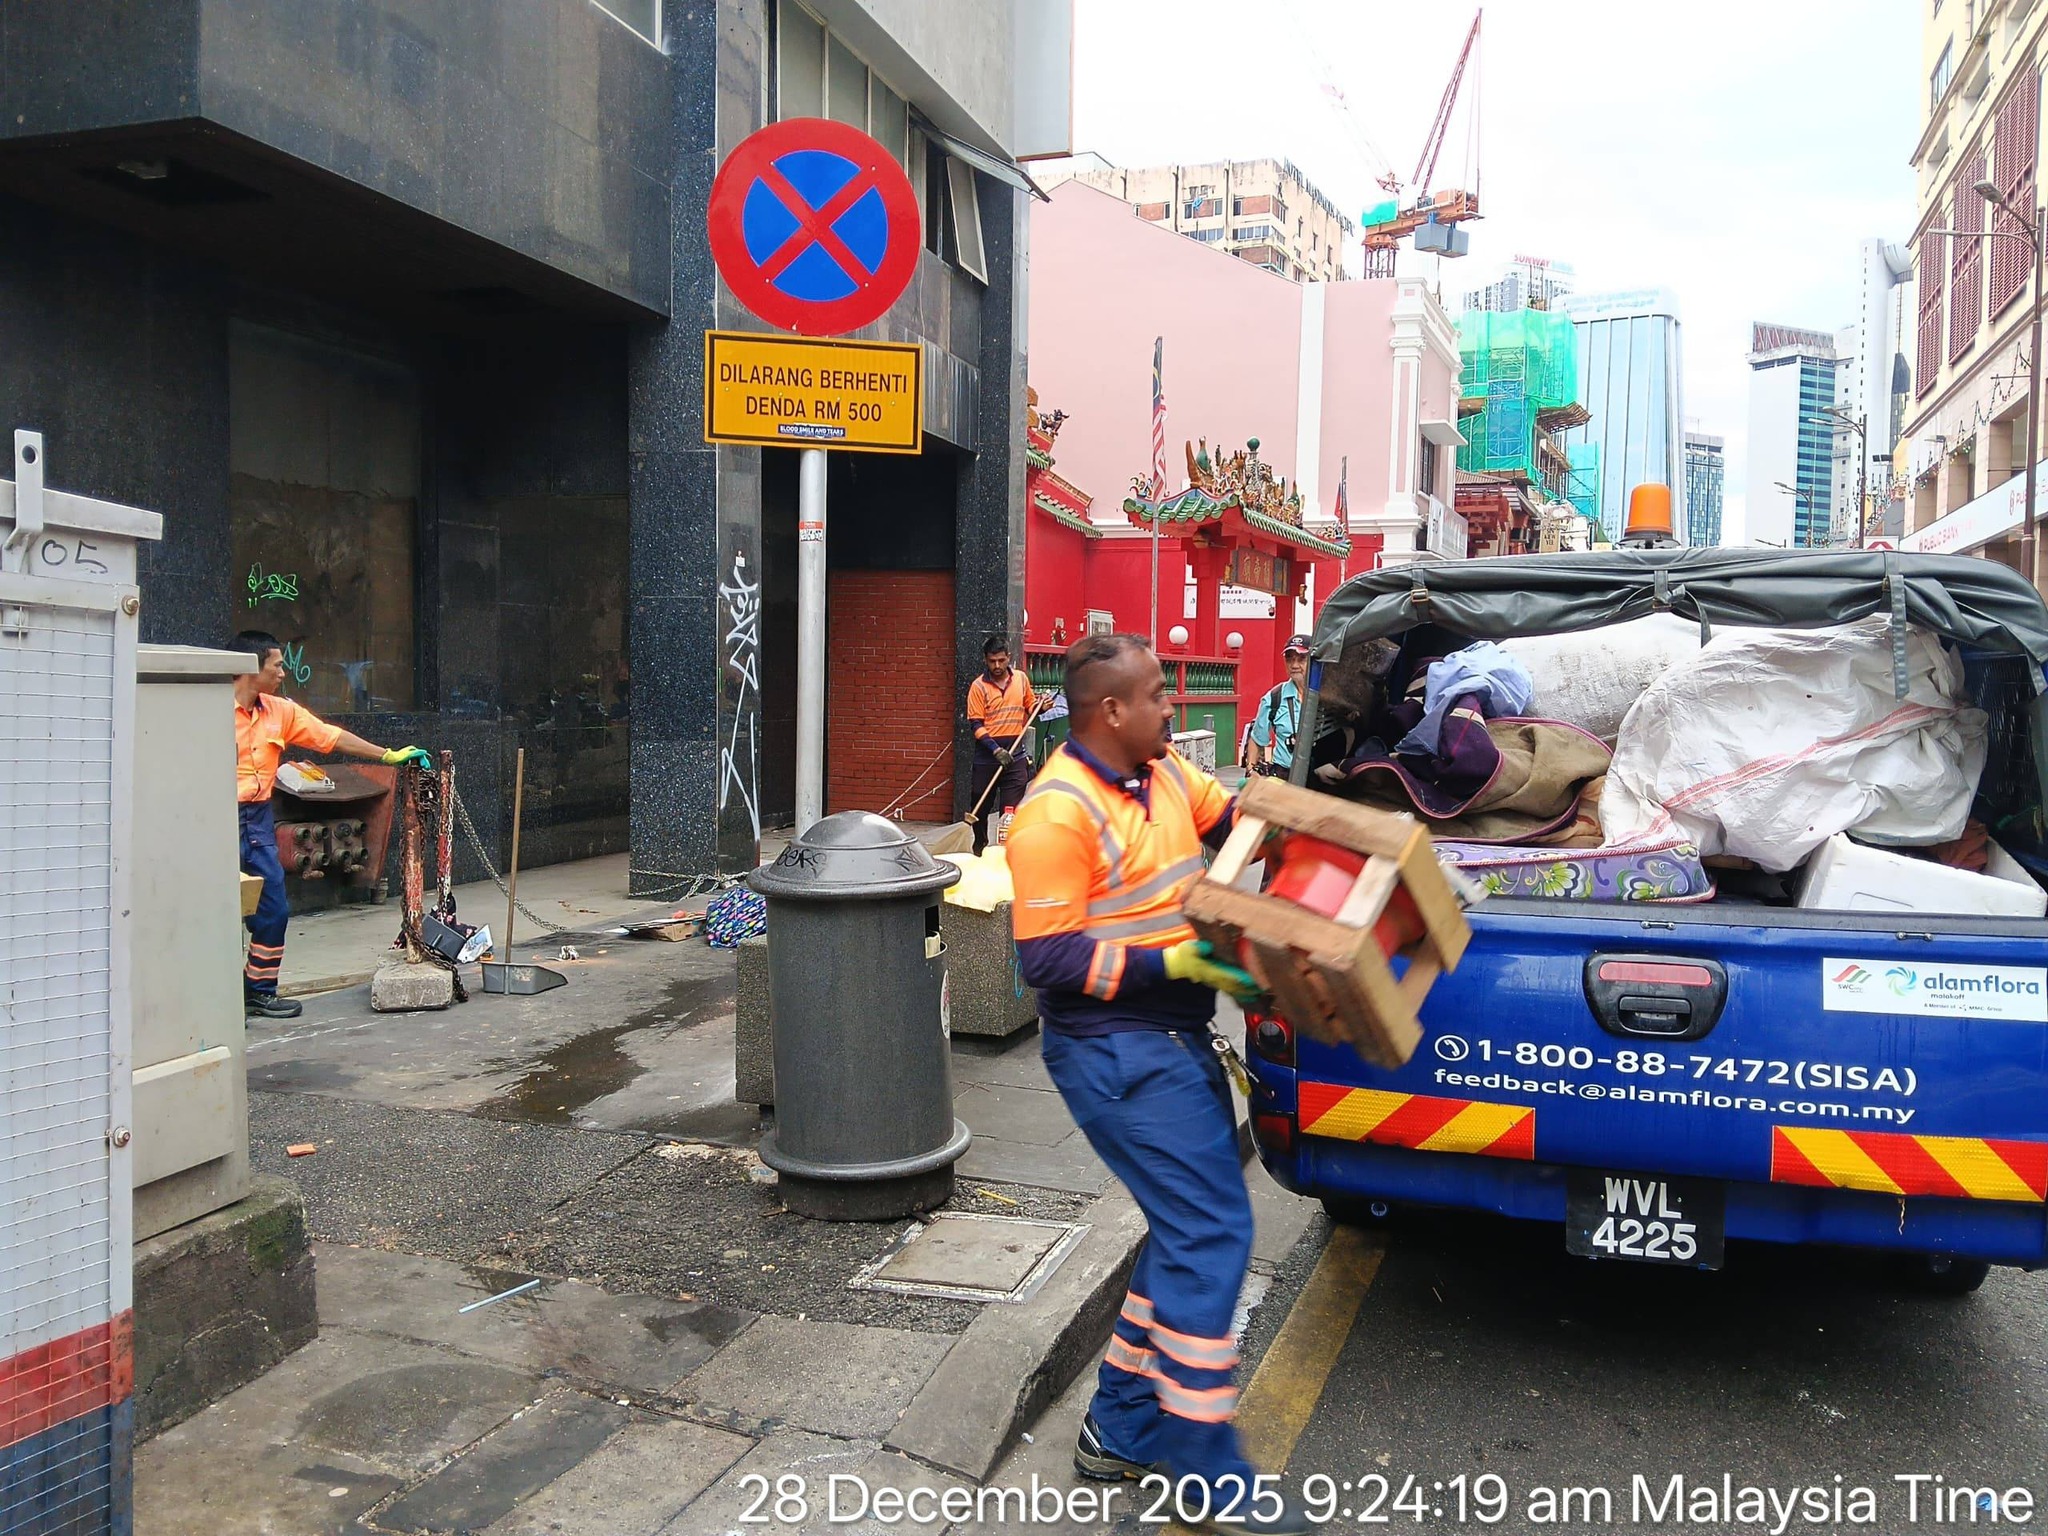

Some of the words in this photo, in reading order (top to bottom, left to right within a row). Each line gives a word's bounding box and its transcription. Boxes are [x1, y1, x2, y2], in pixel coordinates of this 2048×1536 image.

[1514, 254, 1550, 267] SUNWAY
[720, 362, 813, 388] DILARANG
[820, 369, 908, 394] BERHENTI
[746, 396, 807, 418] DENDA
[814, 400, 841, 421] RM
[848, 403, 882, 422] 500
[780, 425, 798, 433] BLOOD
[827, 428, 843, 436] TEARS
[1923, 972, 2040, 995] alamflora
[1930, 993, 1965, 1001] malakoff
[1477, 1039, 1918, 1096] 1-800-88-7472(SISA)
[1434, 1068, 1916, 1125] feedback@alamflora.com.my
[1604, 1176, 1682, 1219] WVL
[1592, 1217, 1697, 1260] 4225
